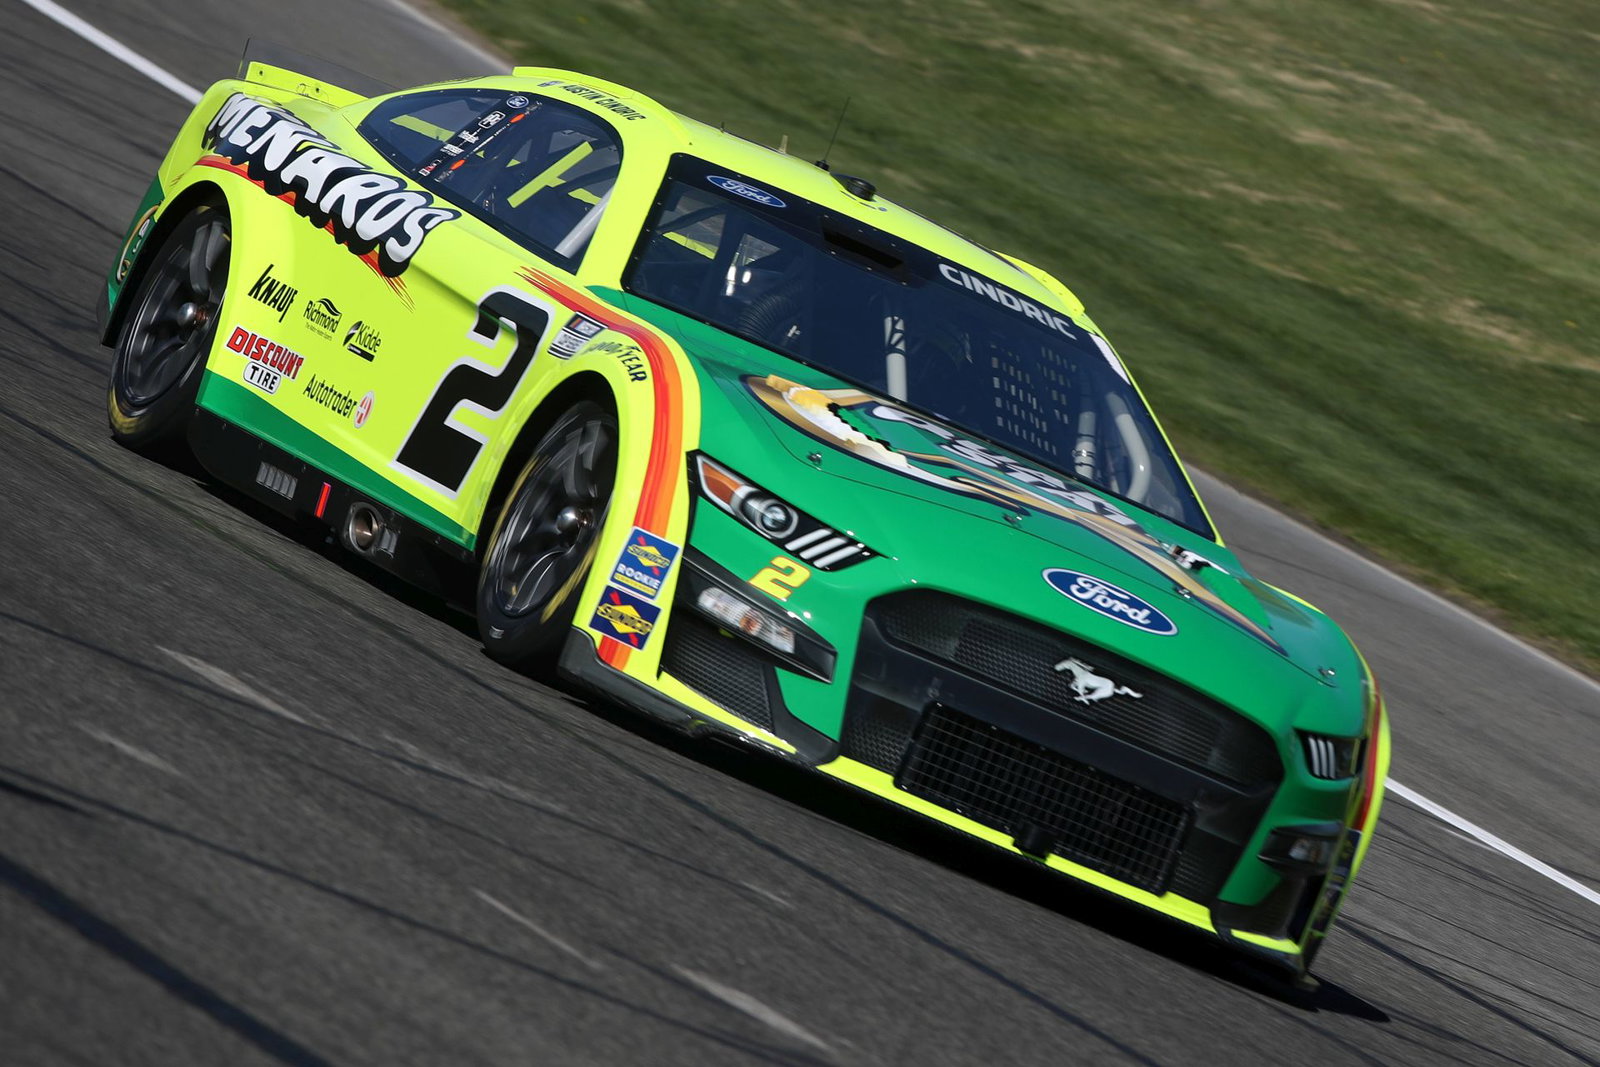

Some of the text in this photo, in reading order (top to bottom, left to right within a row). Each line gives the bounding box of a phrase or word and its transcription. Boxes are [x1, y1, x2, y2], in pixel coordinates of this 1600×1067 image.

[595, 98, 647, 121] CINDRIC
[205, 91, 457, 270] MENARDS
[721, 180, 772, 203] Ford
[247, 264, 299, 323] KNAUF
[937, 263, 1078, 341] CINDRIC
[303, 300, 342, 333] Richmond
[355, 321, 382, 353] Kidde
[226, 326, 305, 380] DISCOUNT
[249, 365, 279, 391] TIRE
[303, 374, 358, 418] Autotrader
[388, 285, 553, 498] 2
[616, 563, 661, 589] ROOKIE
[746, 555, 812, 602] 2
[1069, 577, 1152, 625] Ford
